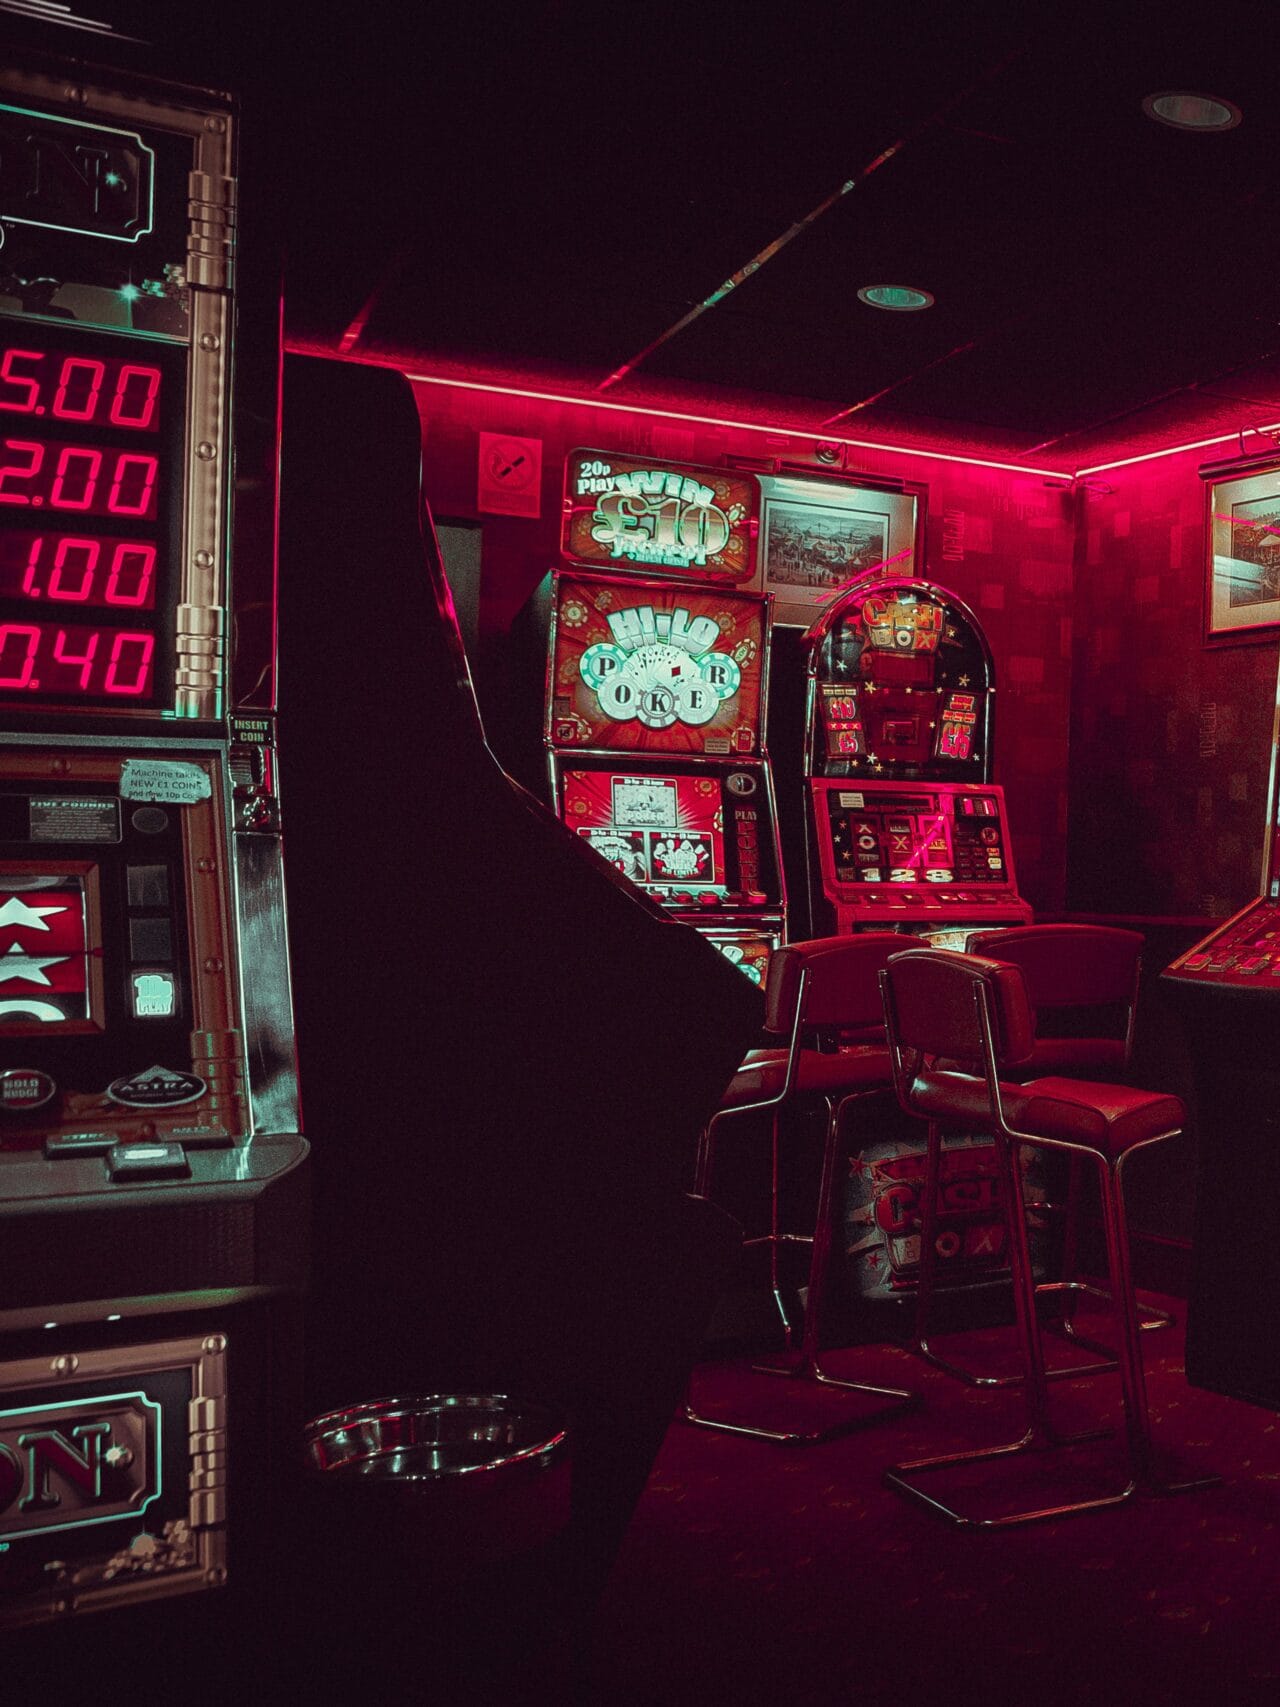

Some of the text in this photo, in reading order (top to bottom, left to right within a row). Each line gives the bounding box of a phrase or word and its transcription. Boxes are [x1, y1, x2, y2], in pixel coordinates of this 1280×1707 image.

[0, 349, 161, 428] 5.00
[0, 439, 158, 516] 2.00
[580, 460, 611, 478] 20p
[577, 477, 617, 495] Play
[613, 471, 715, 506] WIN
[591, 491, 730, 556] £10
[22, 537, 157, 606] 1.00
[0, 624, 155, 694] 0.40
[598, 656, 727, 714] POKER
[234, 719, 269, 732] INSERT
[240, 731, 265, 743] COIN
[131, 768, 174, 778] Machine
[130, 780, 156, 789] NEW
[166, 790, 182, 800] 10p
[734, 810, 758, 821] PLAY
[889, 868, 917, 882] 2
[120, 1081, 195, 1092] ASTRA
[0, 1422, 112, 1513] N
